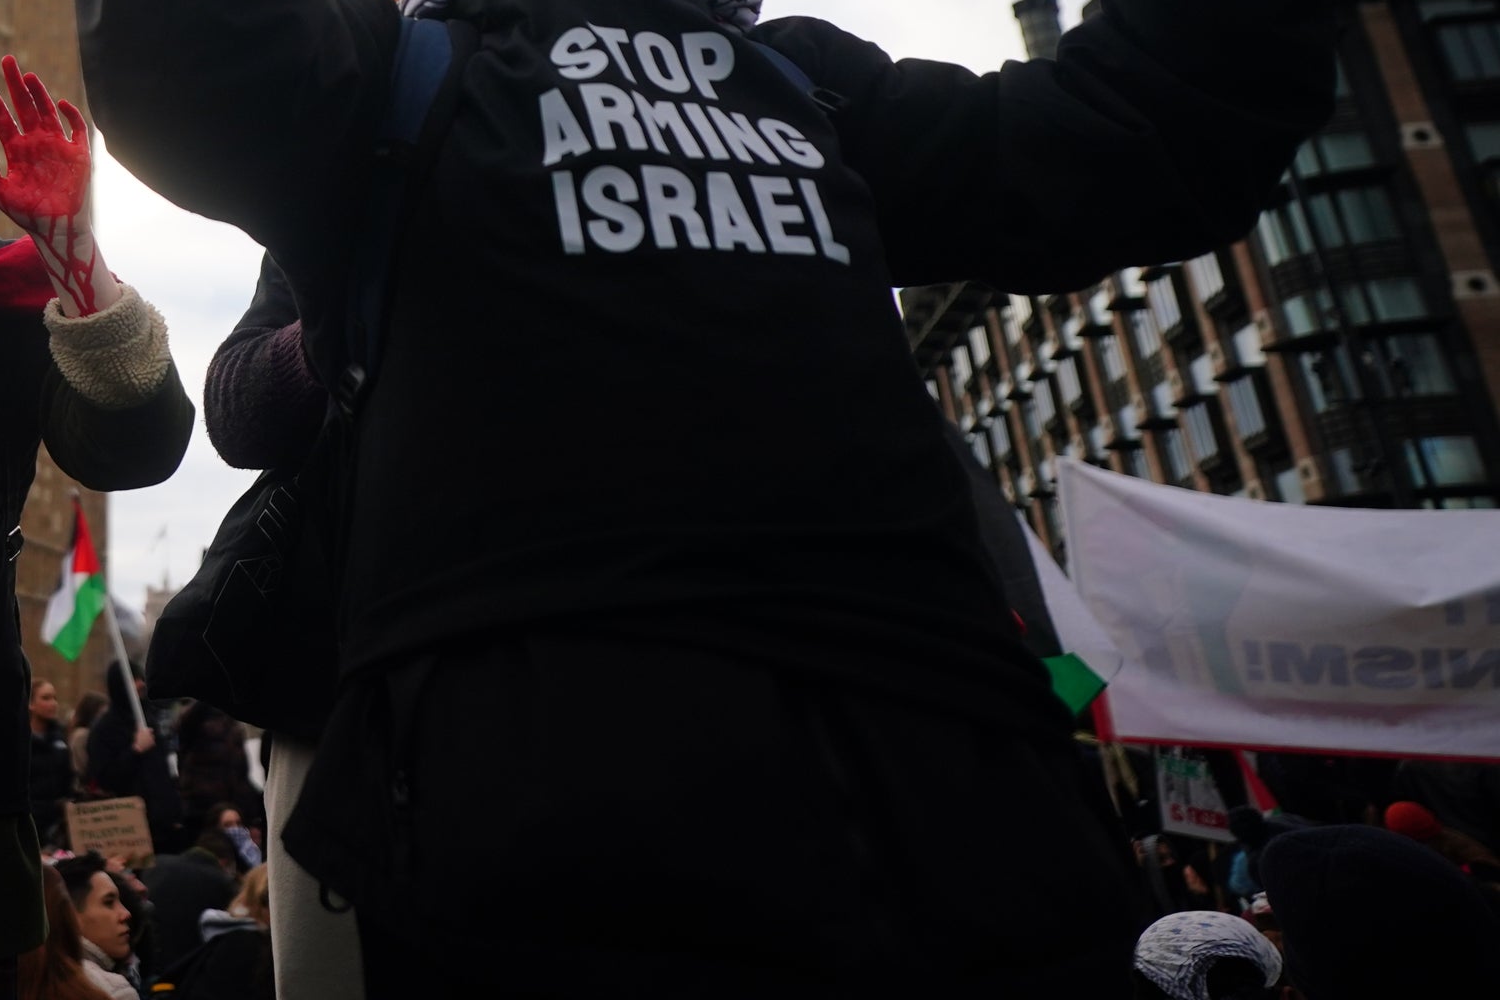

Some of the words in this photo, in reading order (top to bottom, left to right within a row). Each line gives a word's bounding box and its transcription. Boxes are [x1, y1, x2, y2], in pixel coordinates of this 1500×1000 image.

[550, 21, 735, 100] STOP
[539, 82, 825, 169] ARMING
[551, 164, 850, 266] ISRAEL
